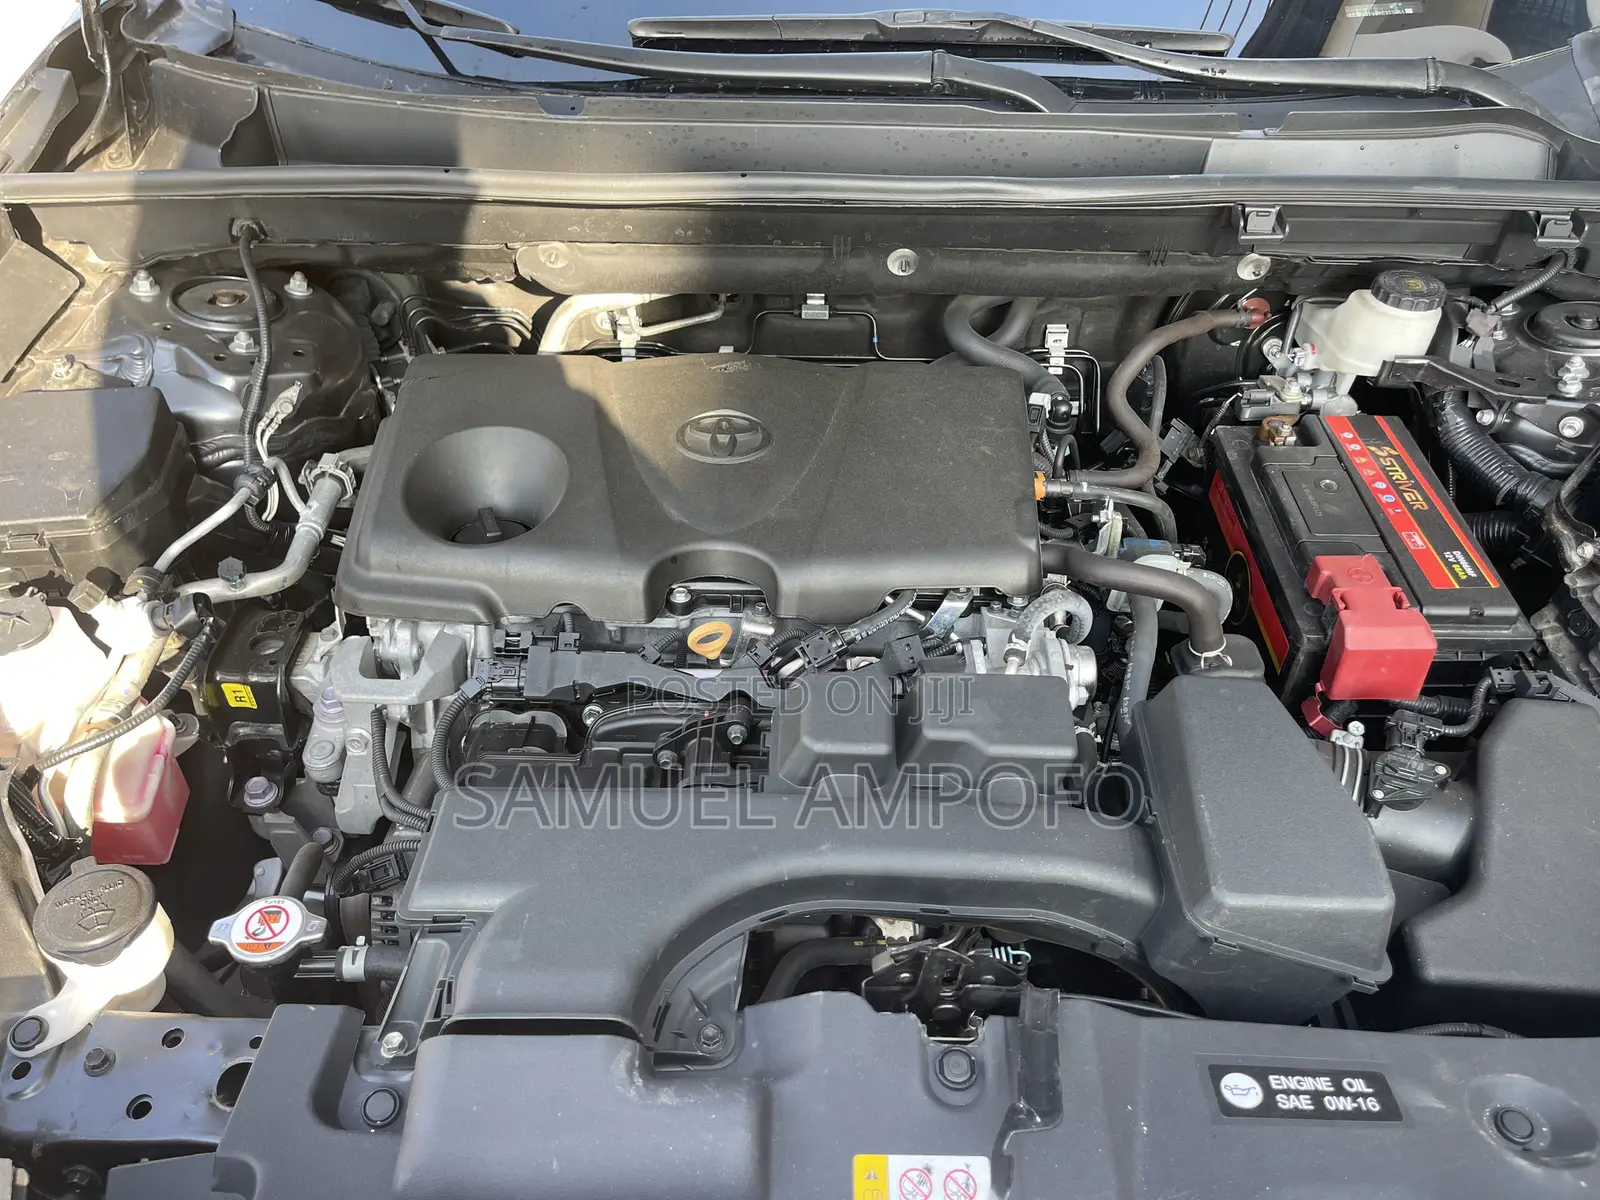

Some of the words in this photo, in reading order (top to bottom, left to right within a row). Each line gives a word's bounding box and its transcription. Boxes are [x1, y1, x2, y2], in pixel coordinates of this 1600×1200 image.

[232, 690, 247, 702] R1
[98, 879, 124, 893] FLUID
[1268, 1075, 1335, 1091] ENGINE
[1342, 1078, 1374, 1093] OIL
[1275, 1094, 1314, 1110] SAE
[1323, 1096, 1382, 1112] 0W-16
